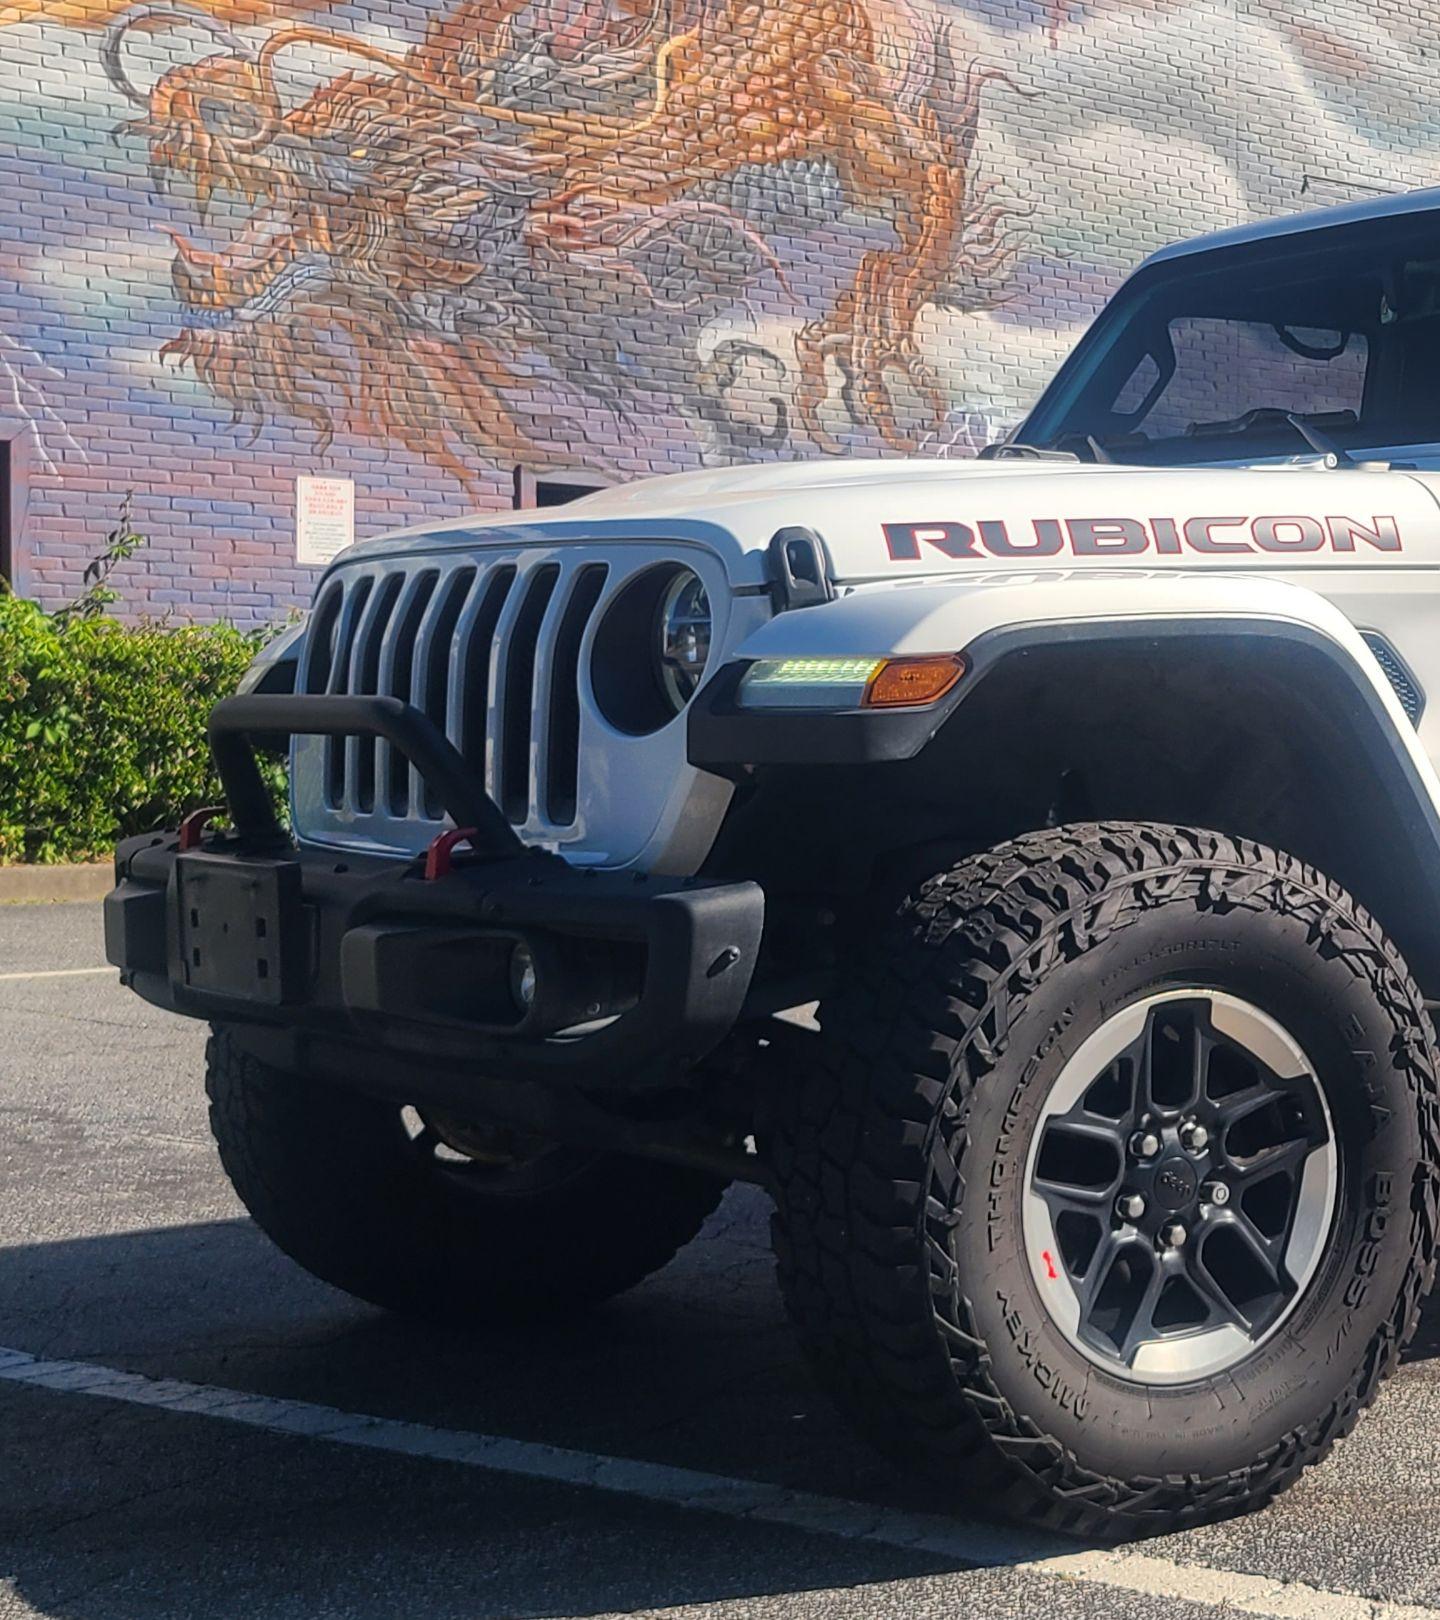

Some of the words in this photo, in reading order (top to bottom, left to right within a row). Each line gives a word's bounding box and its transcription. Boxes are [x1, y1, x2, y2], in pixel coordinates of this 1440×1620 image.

[881, 515, 1402, 560] RUBICON
[987, 1004, 1076, 1252] THOMPSON
[1342, 1171, 1396, 1310] BOSS
[996, 1290, 1089, 1421] MICKEY
